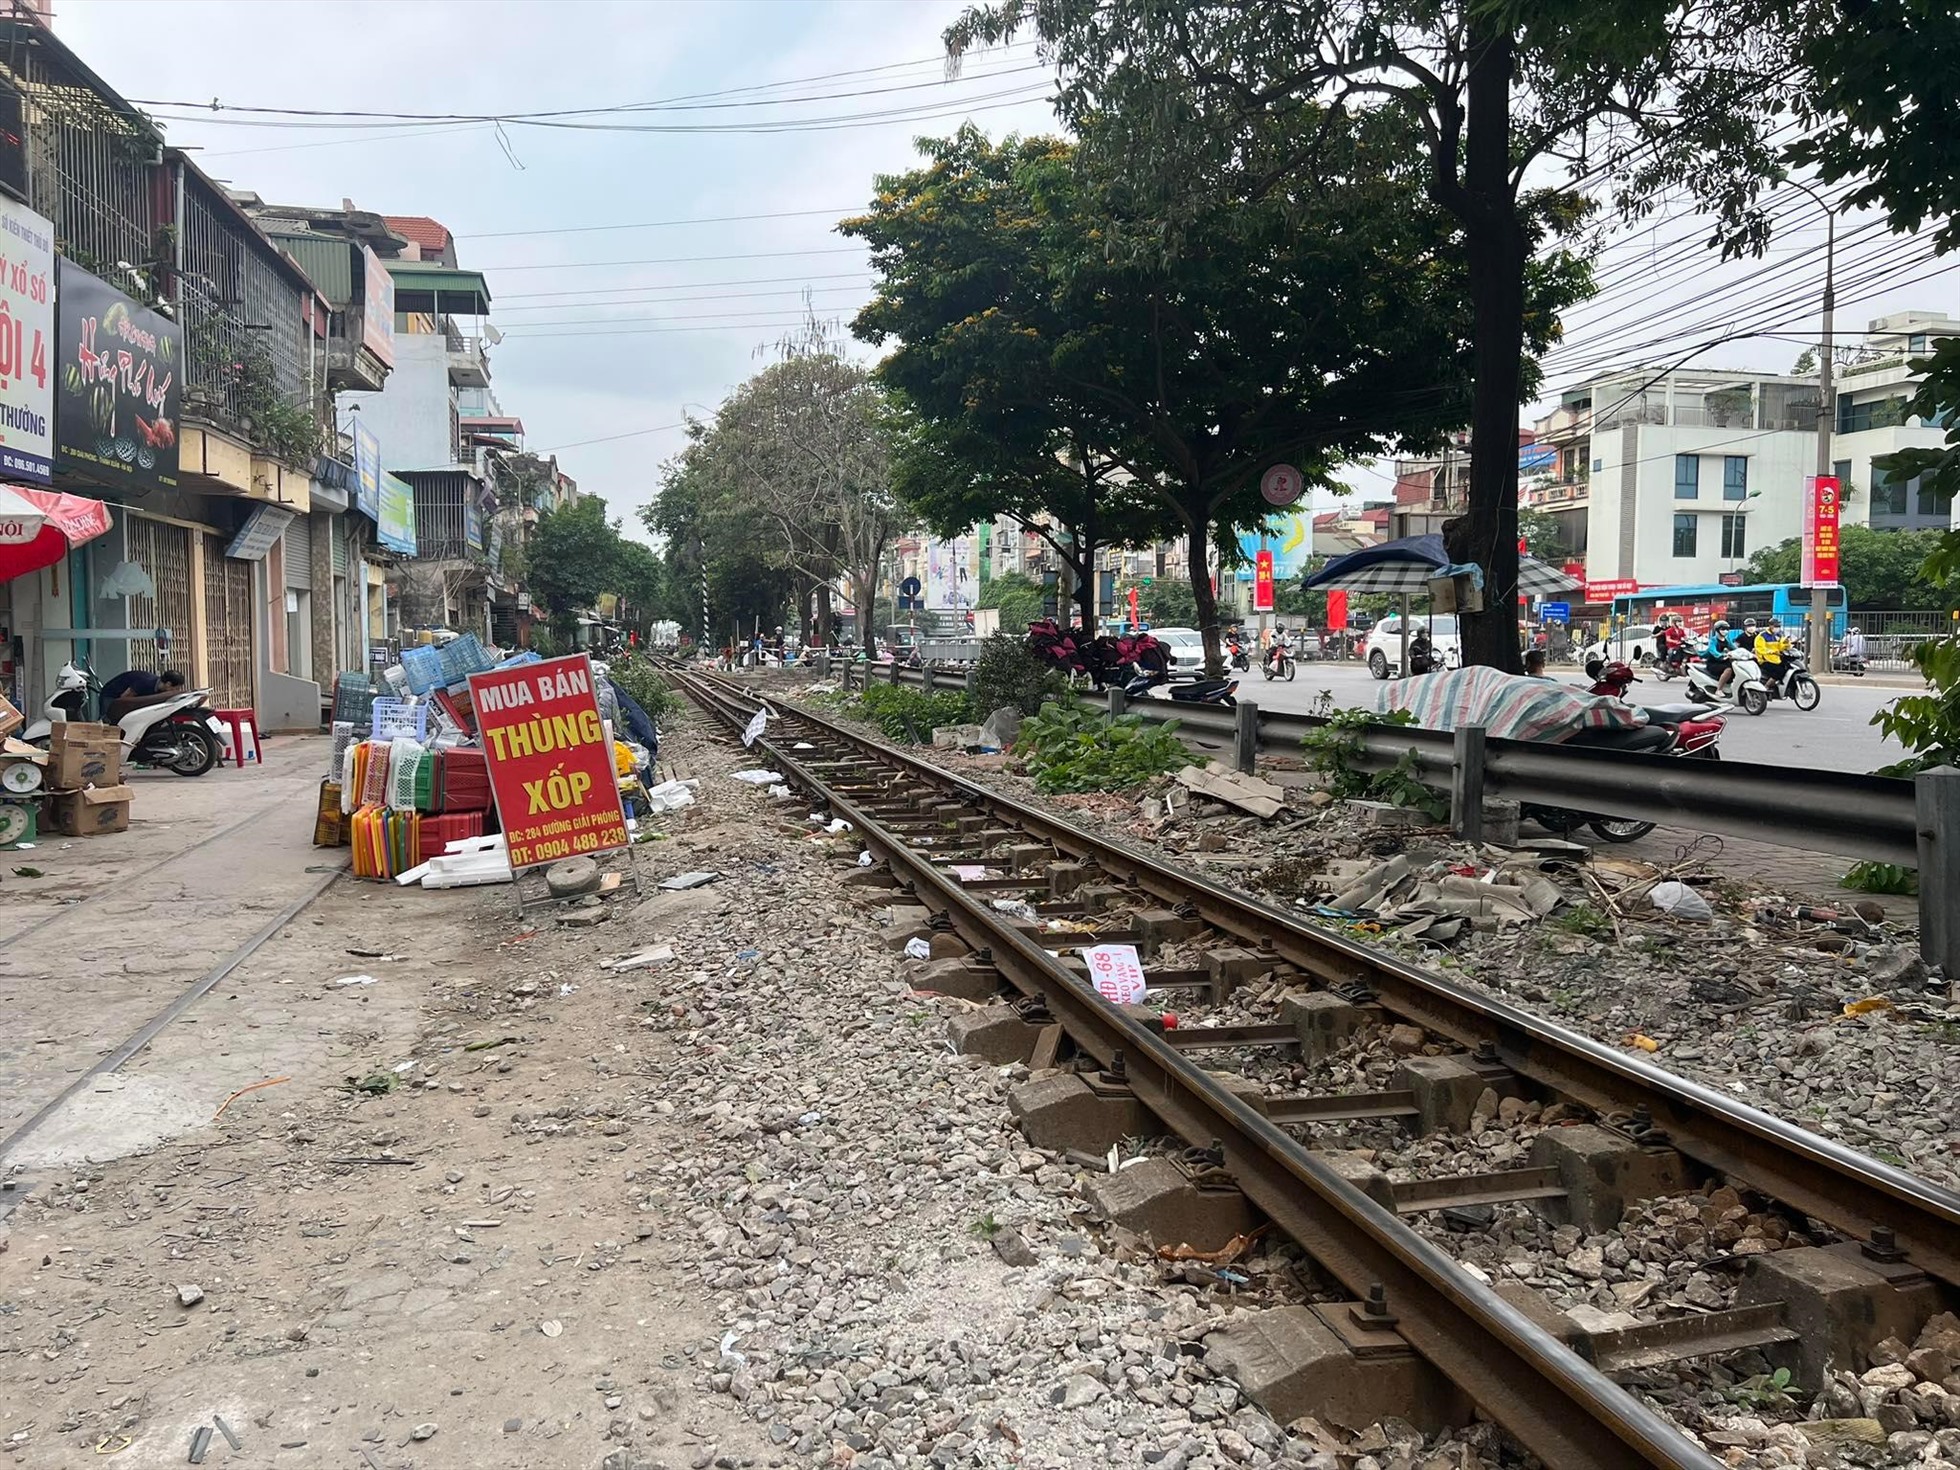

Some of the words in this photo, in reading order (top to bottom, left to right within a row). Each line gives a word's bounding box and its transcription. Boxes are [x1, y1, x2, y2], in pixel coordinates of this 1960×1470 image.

[11, 260, 27, 295] XỔ
[30, 271, 46, 305] SỐ
[31, 329, 46, 389] 4
[0, 403, 46, 437] THƯỞNG
[478, 680, 534, 713] MUA
[537, 668, 589, 701] BÁN
[486, 709, 603, 761] THÙNG
[522, 762, 591, 815] XỐP
[509, 830, 525, 843] ĐC:
[525, 826, 541, 840] 284
[542, 819, 572, 836] ĐƯỜNG
[573, 813, 590, 829] GIẢI
[591, 809, 621, 826] PHÓNG
[511, 846, 533, 865] ĐT:
[535, 838, 570, 860] 0904
[573, 832, 598, 851] 488
[601, 826, 626, 846] 238
[1094, 952, 1112, 972] 68
[1128, 964, 1140, 991] VIP
